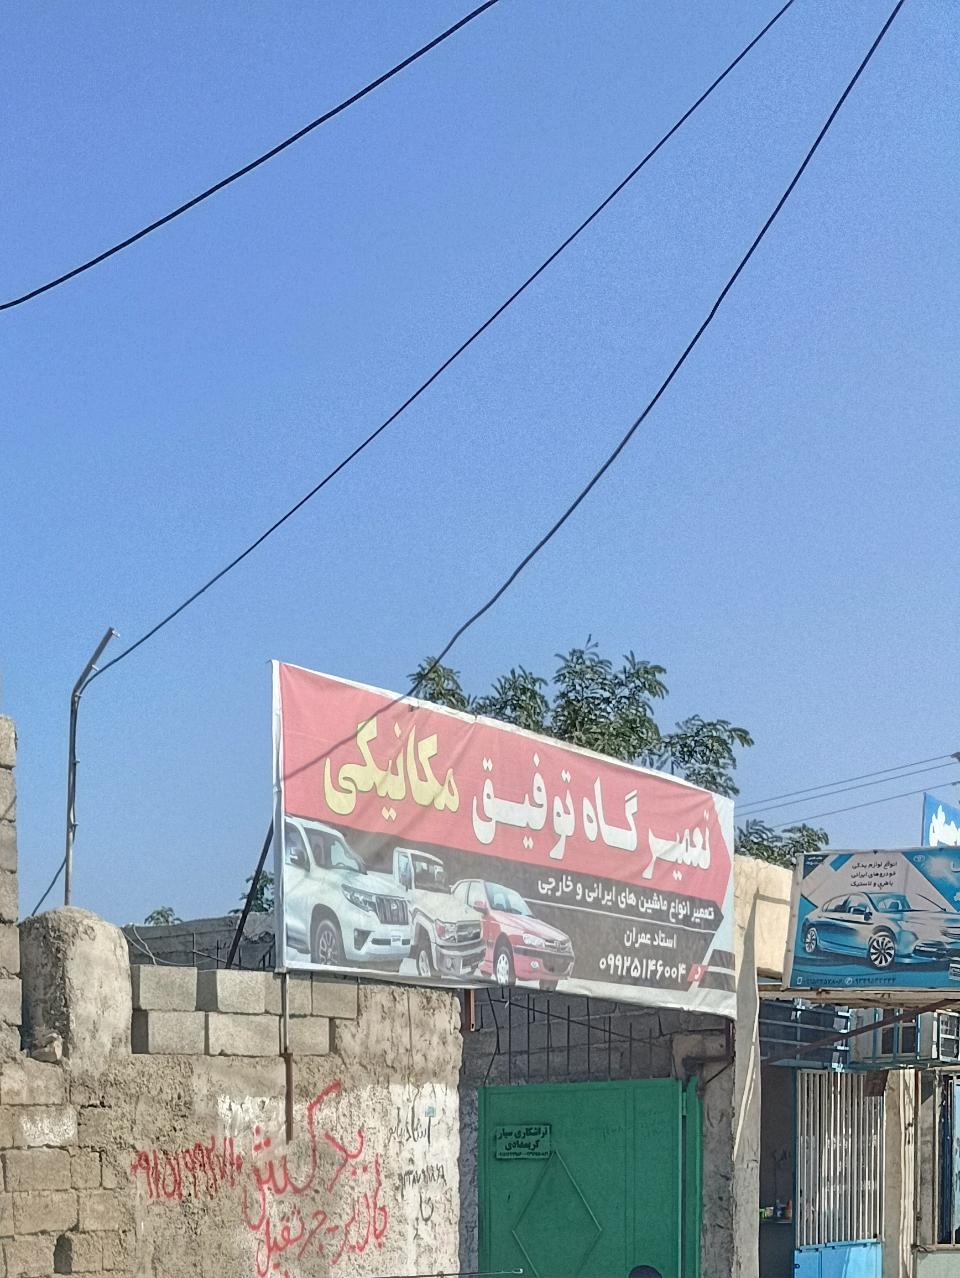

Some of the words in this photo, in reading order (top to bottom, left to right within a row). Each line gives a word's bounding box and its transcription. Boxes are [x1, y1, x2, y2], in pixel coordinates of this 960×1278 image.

[324, 717, 460, 820] مکانیکی
[473, 754, 575, 860] توفیق
[583, 778, 638, 852] گاه
[642, 809, 711, 880] تعمیر
[538, 875, 573, 897] خارجی
[576, 883, 582, 899] و
[585, 883, 615, 904] ایرانی
[618, 892, 636, 909] های
[639, 894, 668, 913] ماشین
[669, 900, 690, 922] انواع
[691, 907, 714, 922] تعمیر
[624, 927, 651, 948] عمران
[653, 931, 676, 949] استاد
